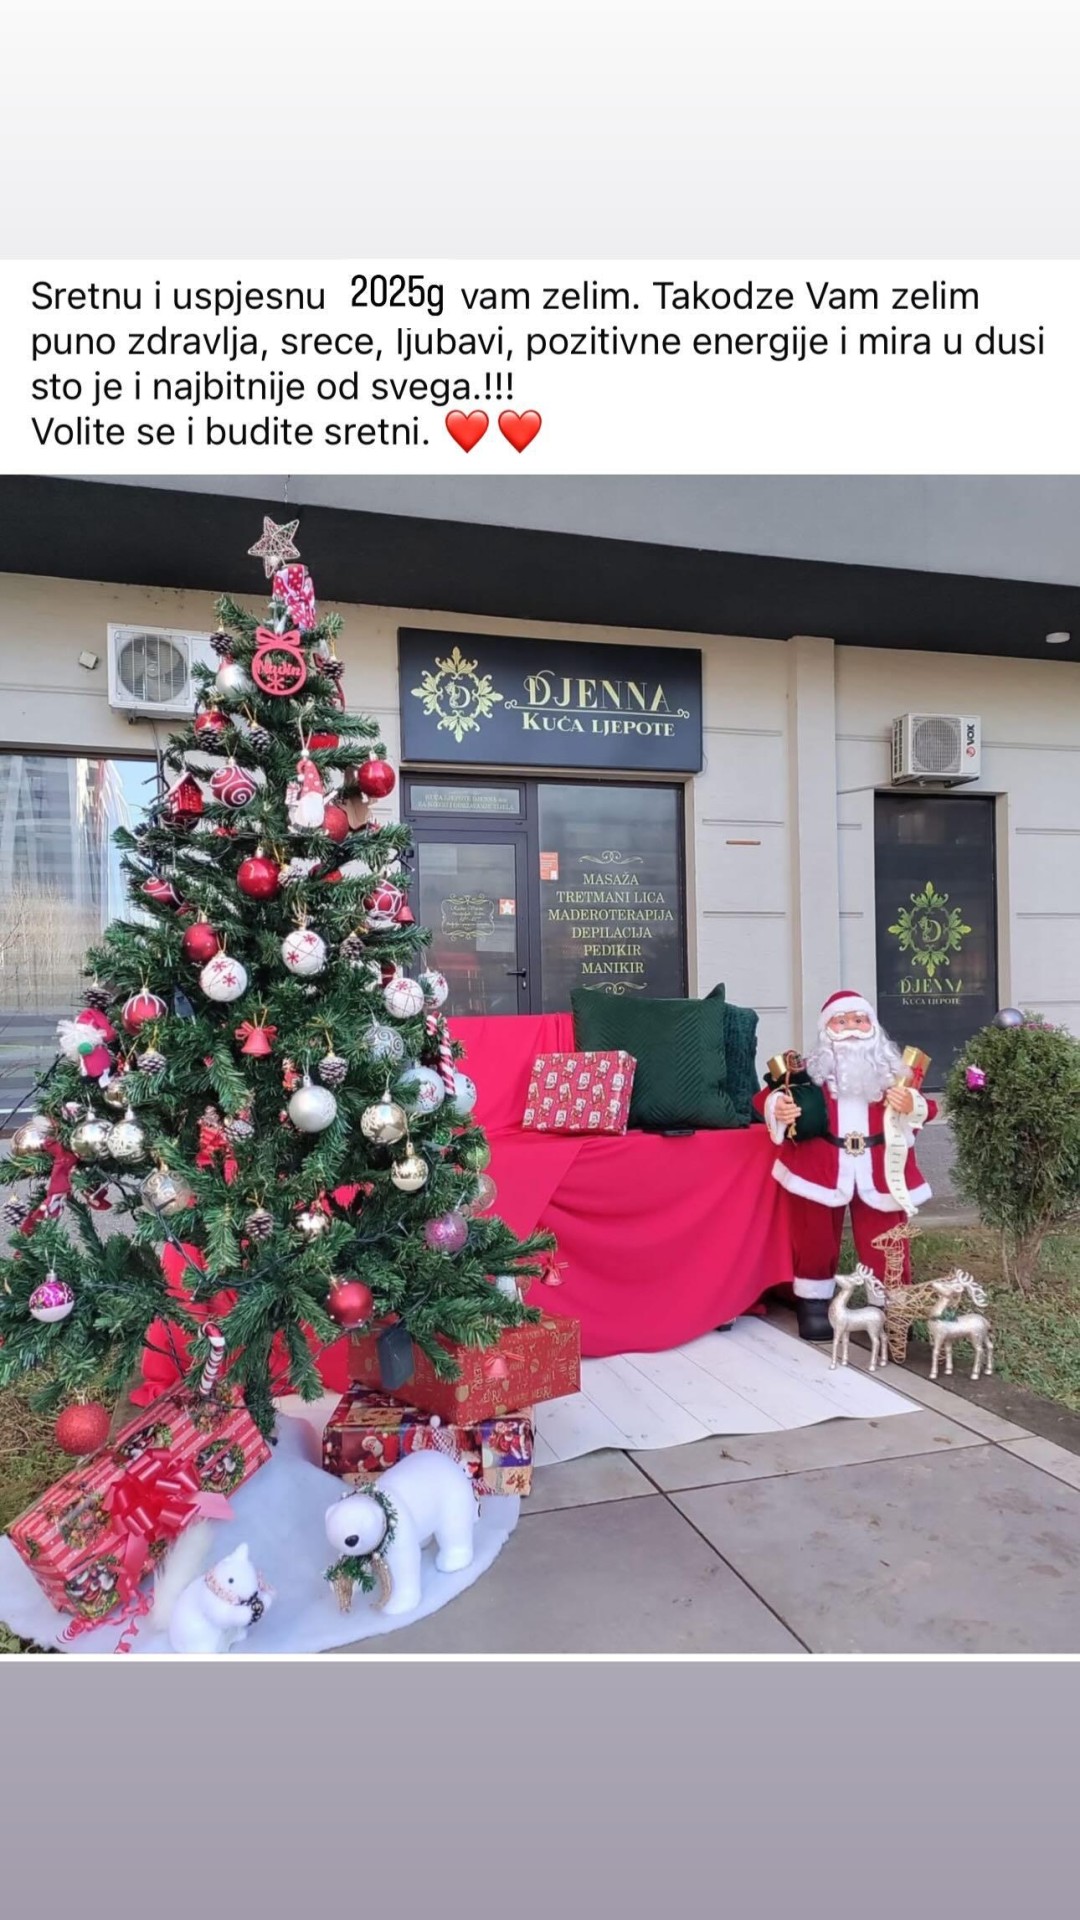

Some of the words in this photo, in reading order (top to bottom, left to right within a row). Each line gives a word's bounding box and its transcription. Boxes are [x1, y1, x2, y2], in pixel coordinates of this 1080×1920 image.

[523, 670, 672, 713] DJENNA
[522, 712, 585, 733] KUĆA
[592, 719, 675, 737] LJEPOTE
[967, 724, 975, 746] VOX
[583, 872, 639, 885] MASAŽA
[556, 891, 629, 903] TRETMANI
[634, 892, 665, 904] LICA
[548, 909, 674, 921] MADEROTERAPIJA
[572, 927, 653, 939] DEPILACIJA
[584, 944, 642, 957] PEDIKIR
[582, 962, 644, 974] MANIKIR
